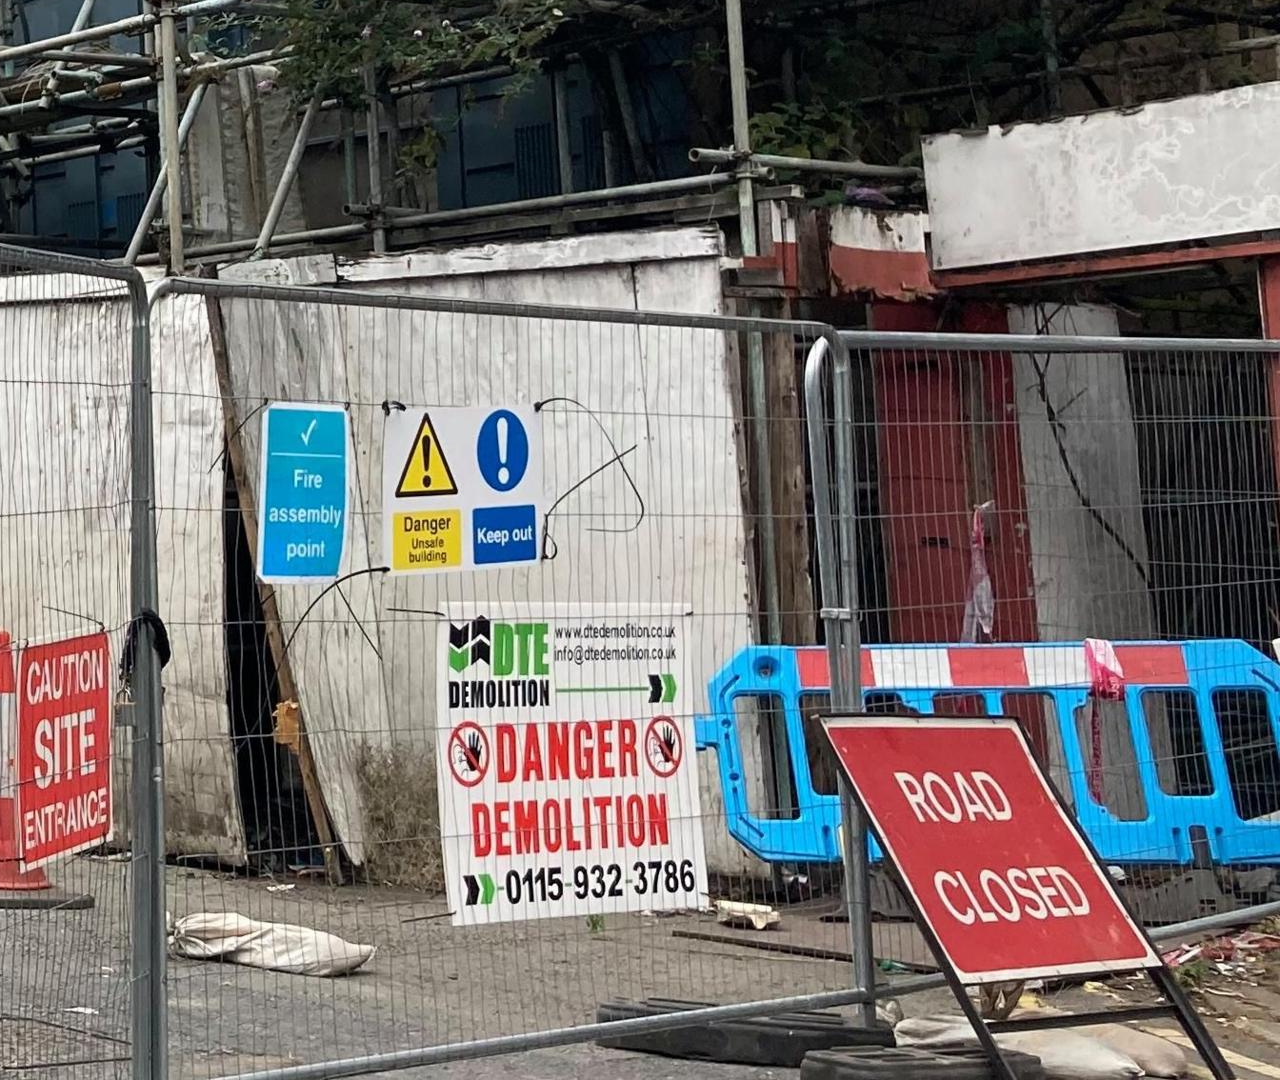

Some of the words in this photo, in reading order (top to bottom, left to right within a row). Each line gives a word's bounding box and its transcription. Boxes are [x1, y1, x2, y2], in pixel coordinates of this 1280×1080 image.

[293, 469, 323, 489] Fire
[269, 505, 342, 529] assembly
[403, 516, 452, 535] Danger
[411, 536, 445, 550] Unsafe
[477, 526, 510, 546] Keep
[513, 525, 533, 542] out
[286, 540, 325, 562] point
[409, 550, 447, 565] building
[493, 623, 549, 676] DTE
[554, 623, 676, 640] www.dtedemolition.co.uk
[553, 645, 677, 665] info@dtedemolition.co.uk
[26, 648, 105, 706] CAUTION
[448, 679, 550, 709] DEMOLITION
[34, 708, 96, 789] SITE
[496, 719, 639, 783] DANGER
[893, 771, 1013, 823] ROAD
[23, 787, 108, 851] ENTRANCE
[471, 793, 670, 858] DEMOLITION
[933, 866, 1090, 926] CLOSED
